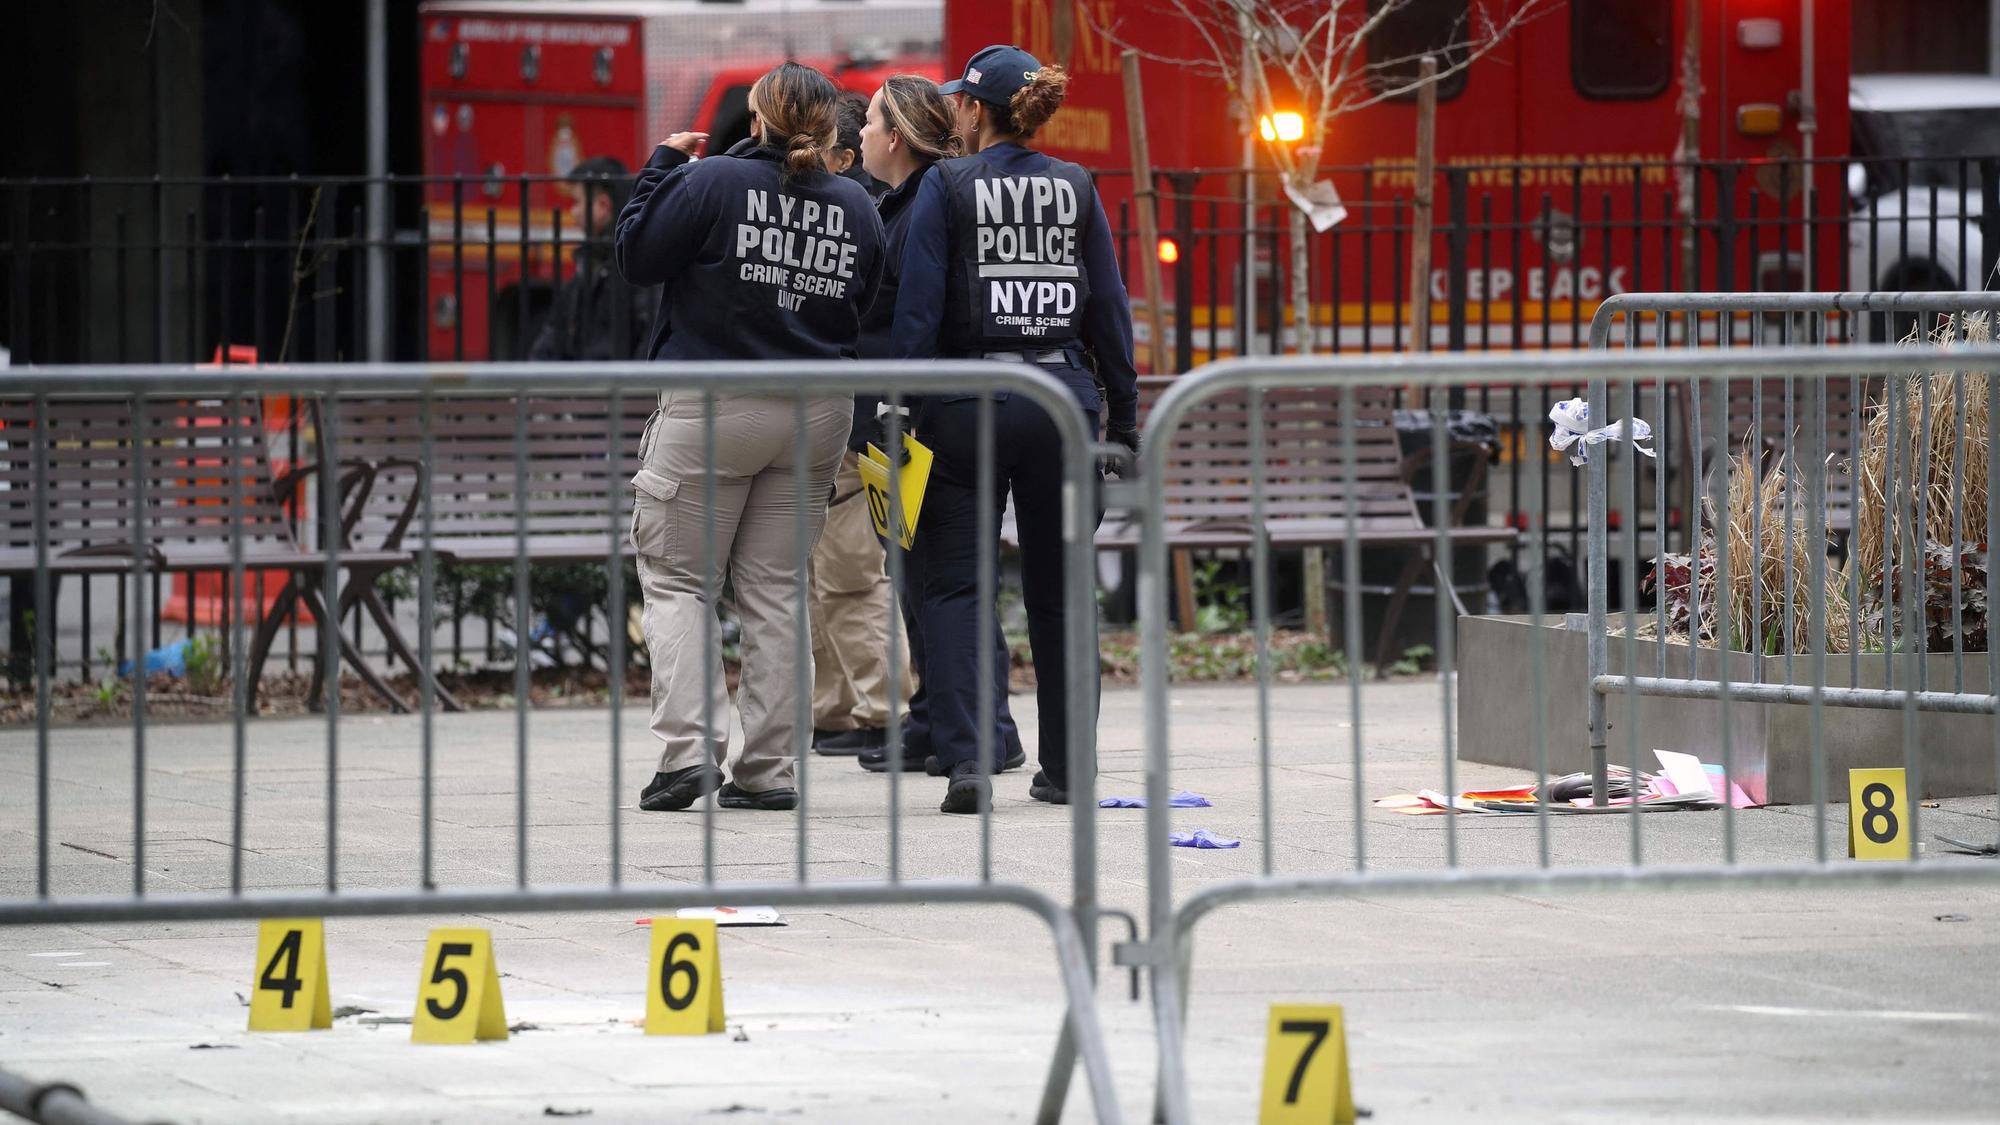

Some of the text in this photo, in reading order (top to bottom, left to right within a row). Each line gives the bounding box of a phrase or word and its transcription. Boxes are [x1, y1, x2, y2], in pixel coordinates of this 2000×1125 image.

[1372, 156, 1418, 187] FIR
[747, 189, 851, 240] N.Y.P.D.
[975, 177, 1078, 225] NYPD
[736, 223, 858, 279] POLICE
[977, 226, 1077, 264] POLICE
[740, 262, 847, 299] CRIME SCENE
[990, 280, 1077, 315] NYPD
[1430, 267, 1514, 302] KEP
[995, 315, 1071, 328] CRIME SCENE
[1021, 325, 1047, 336] UNIT
[1861, 782, 1899, 844] 8
[259, 929, 303, 1009] 4
[425, 943, 473, 1020] 5
[660, 932, 701, 1011] 6
[1280, 1020, 1330, 1104] 7
